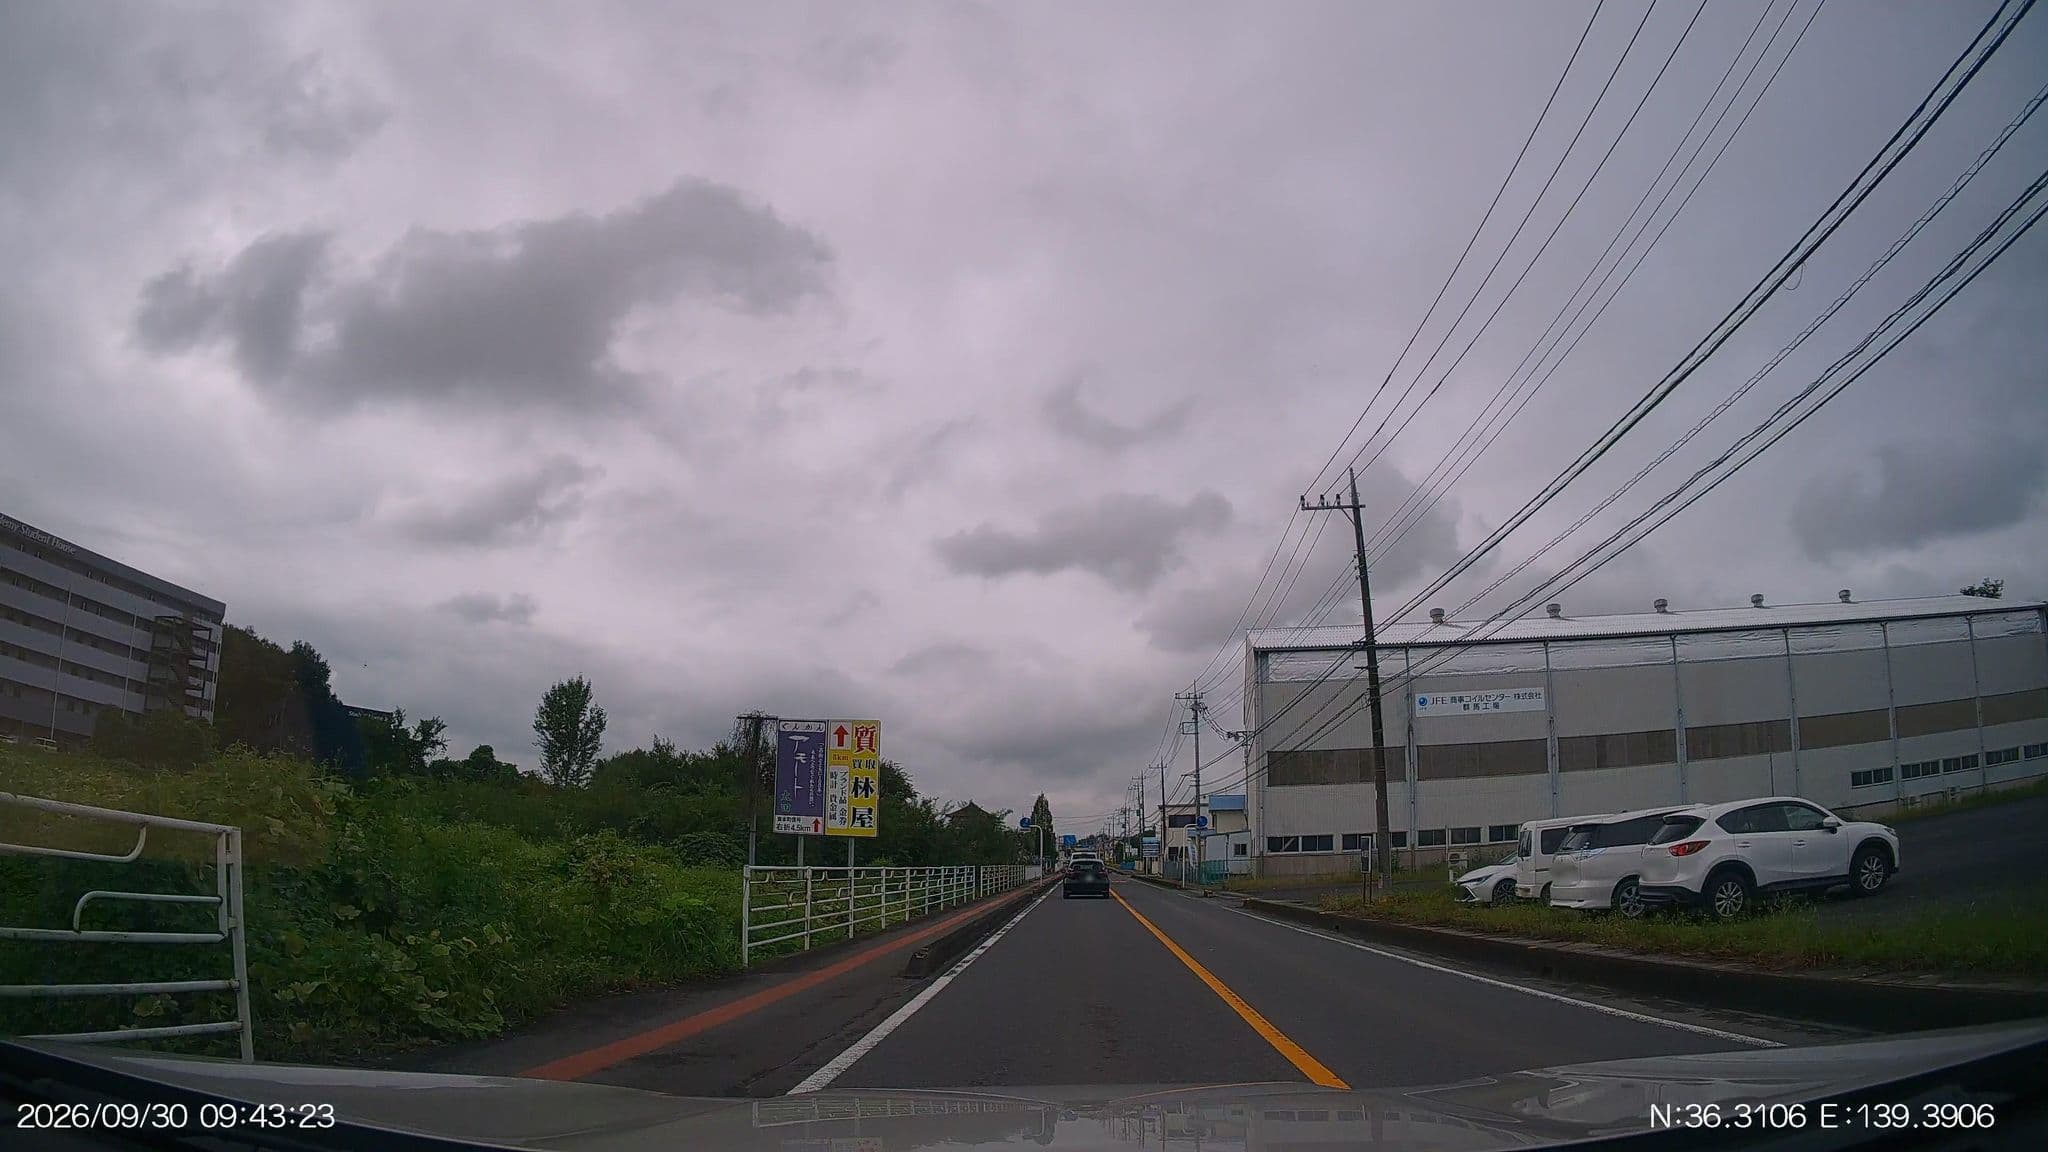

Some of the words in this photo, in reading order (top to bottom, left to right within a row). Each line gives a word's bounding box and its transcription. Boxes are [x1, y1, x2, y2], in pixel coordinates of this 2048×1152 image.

[21, 524, 50, 544] Student
[51, 536, 77, 554] House
[1430, 696, 1448, 705] JFE
[1513, 691, 1543, 701] 株式会社
[854, 725, 877, 753] 質
[852, 759, 876, 769] 買取
[850, 776, 875, 829] 林屋
